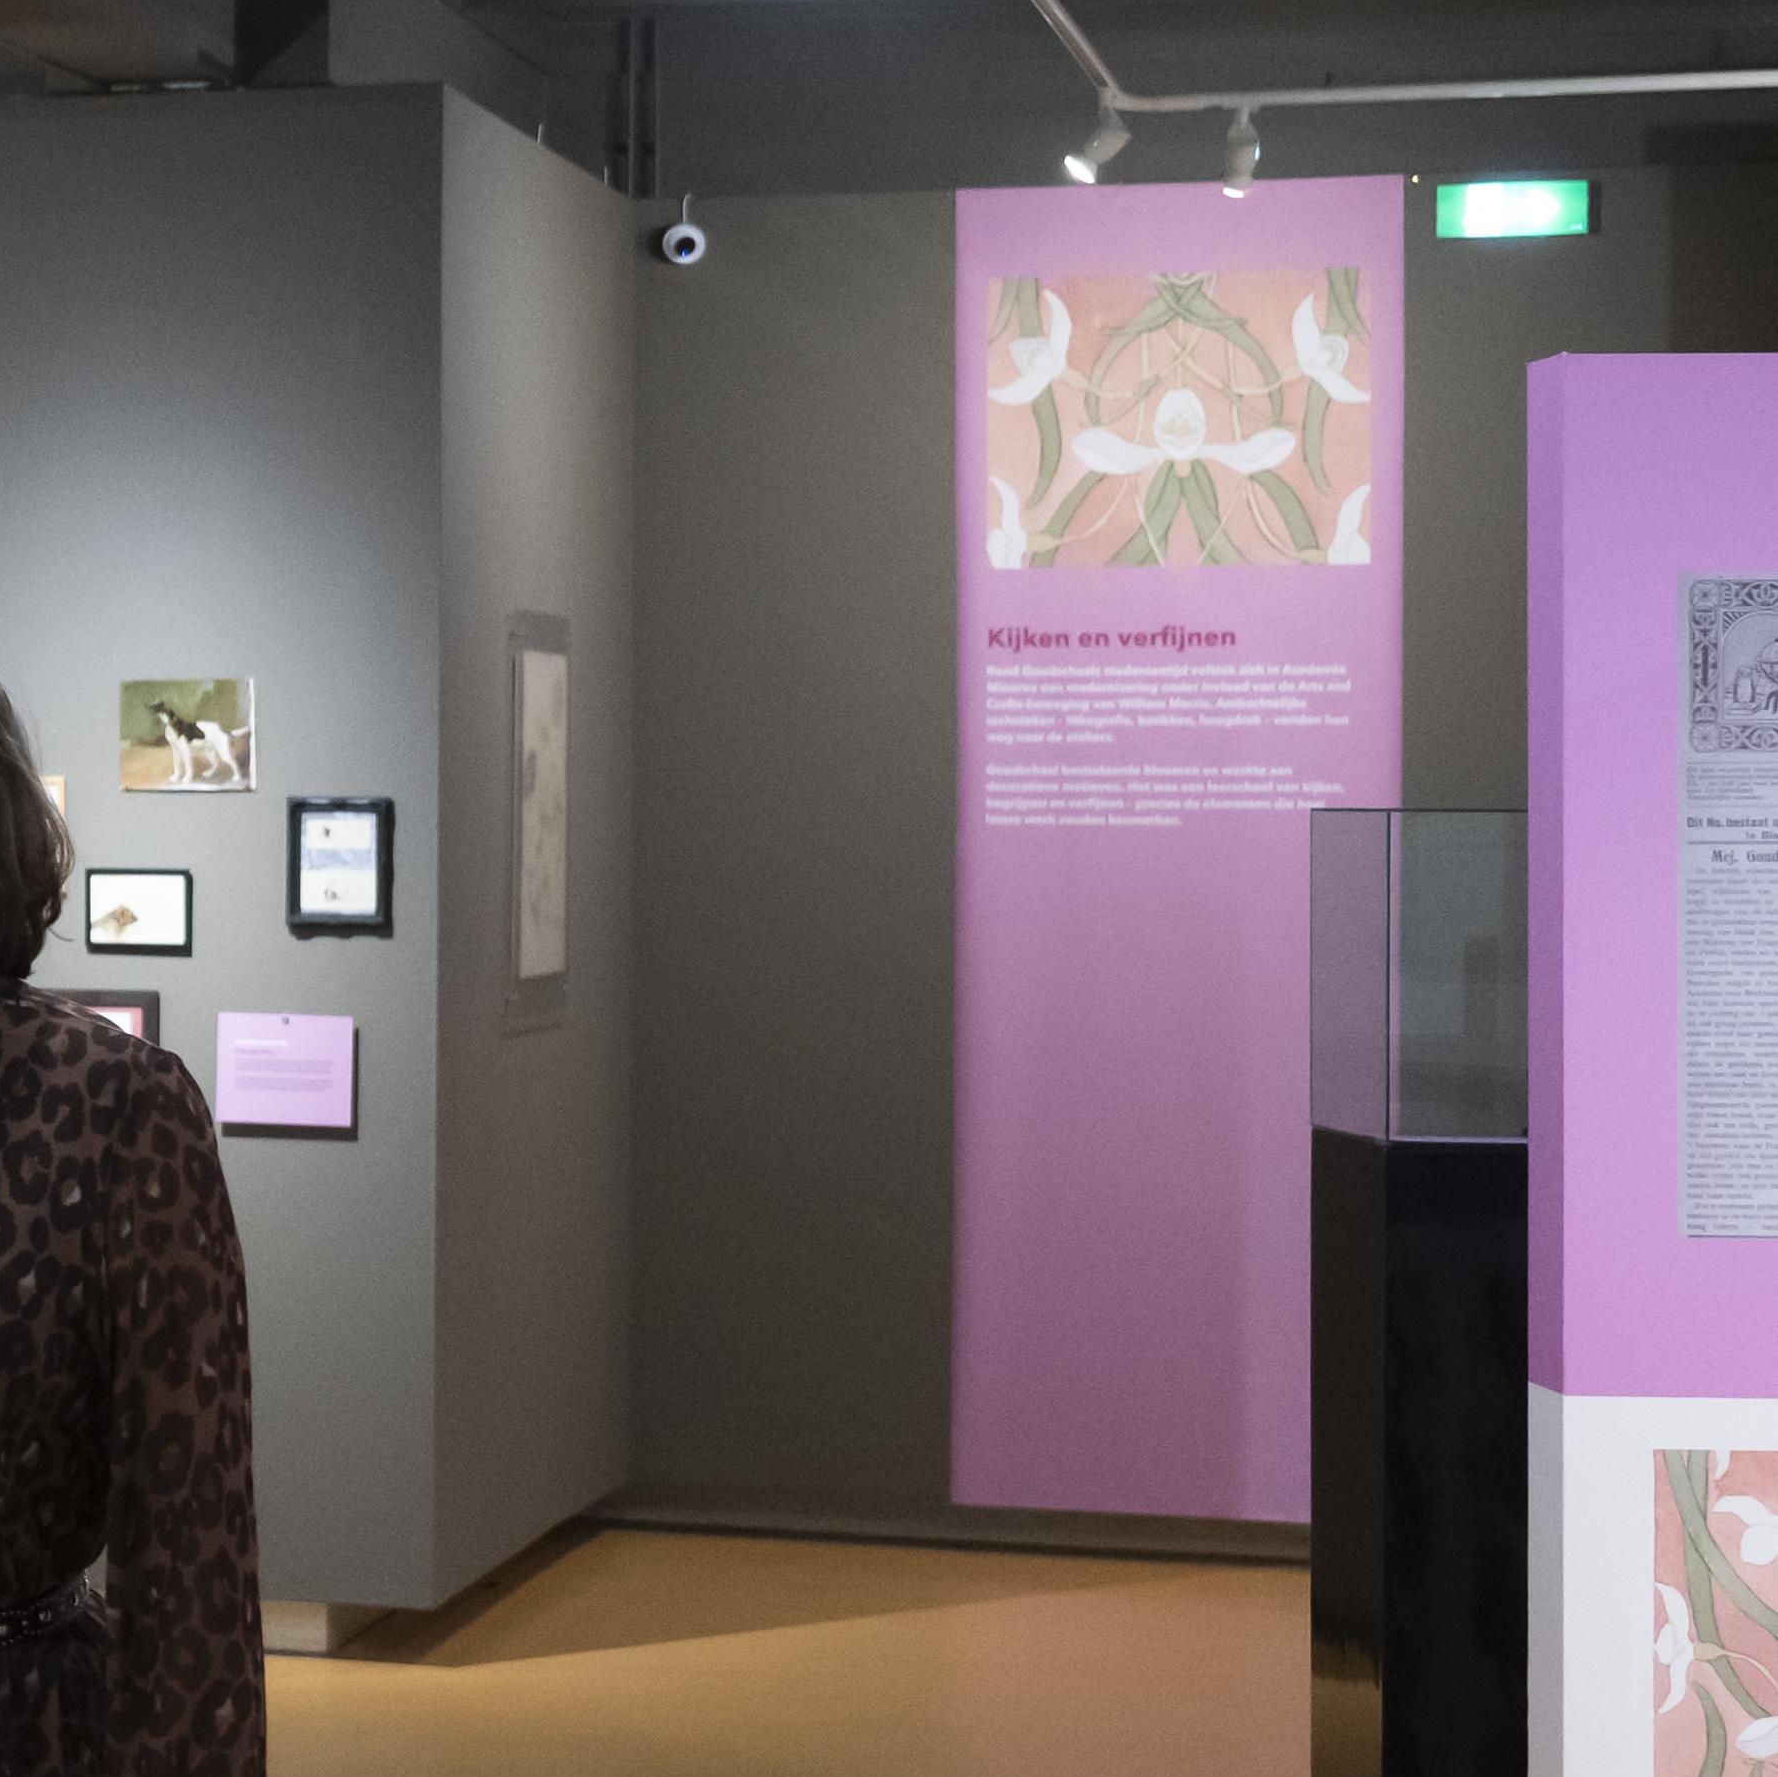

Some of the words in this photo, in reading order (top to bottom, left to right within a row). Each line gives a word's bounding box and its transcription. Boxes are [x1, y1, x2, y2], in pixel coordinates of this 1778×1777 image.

[987, 625, 1070, 653] Kijken
[1078, 631, 1110, 647] en
[1117, 624, 1238, 653] verfijnen
